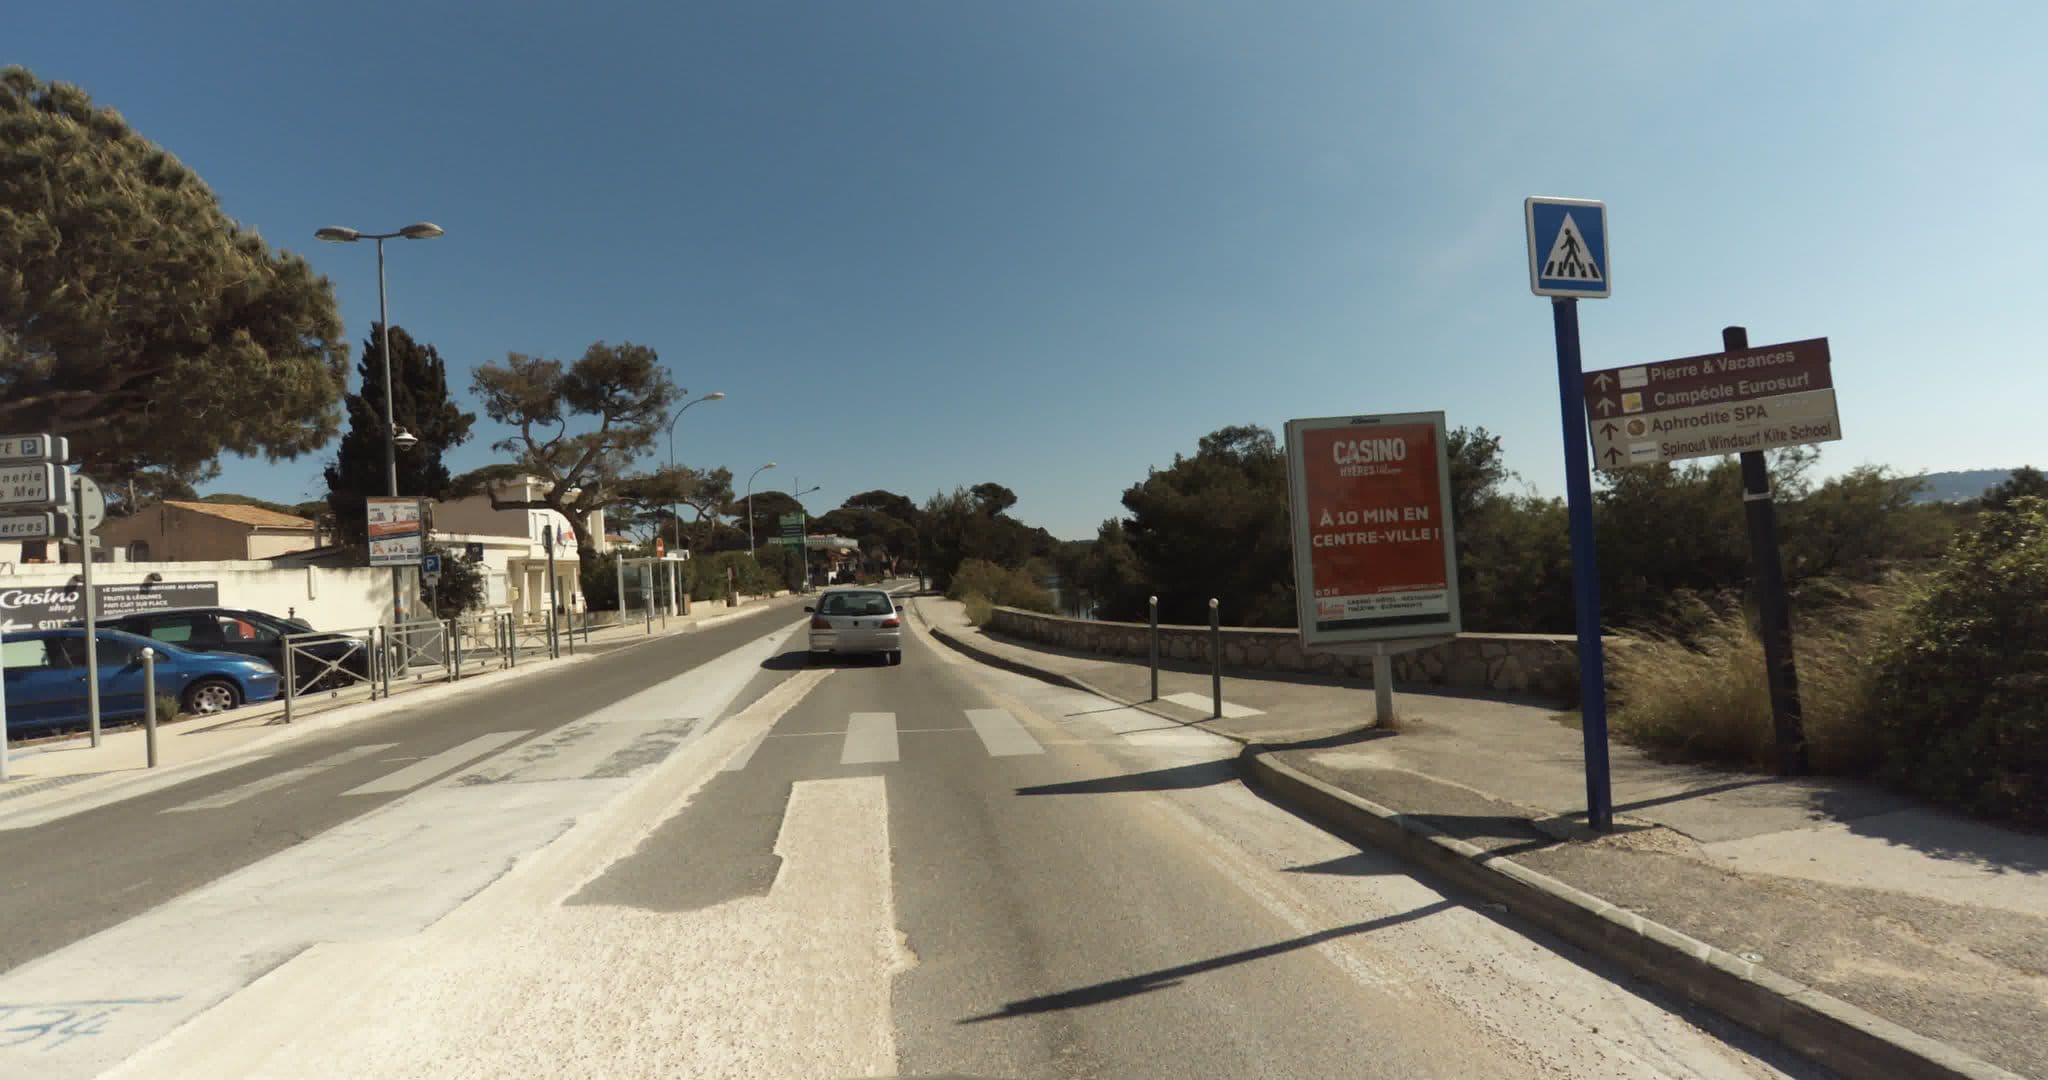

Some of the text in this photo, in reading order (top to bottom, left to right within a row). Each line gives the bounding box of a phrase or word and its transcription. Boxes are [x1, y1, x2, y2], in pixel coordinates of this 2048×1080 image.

[1651, 350, 1795, 381] Pierre & Vacances
[1654, 372, 1809, 406] Campéole Eurosurf
[1652, 404, 1768, 434] Aphrodite SPA
[1661, 437, 1707, 457] Spinout
[1708, 431, 1761, 450] Windsurf
[1764, 428, 1787, 442] Kite
[1790, 421, 1832, 440] School
[1333, 437, 1406, 464] CASINO
[14, 486, 42, 496] Mer
[1319, 506, 1429, 526] À 10 MIN EN
[1312, 528, 1431, 548] CENTRE-VILLE
[426, 558, 435, 570] P
[0, 588, 80, 608] Casino
[48, 603, 76, 614] shop
